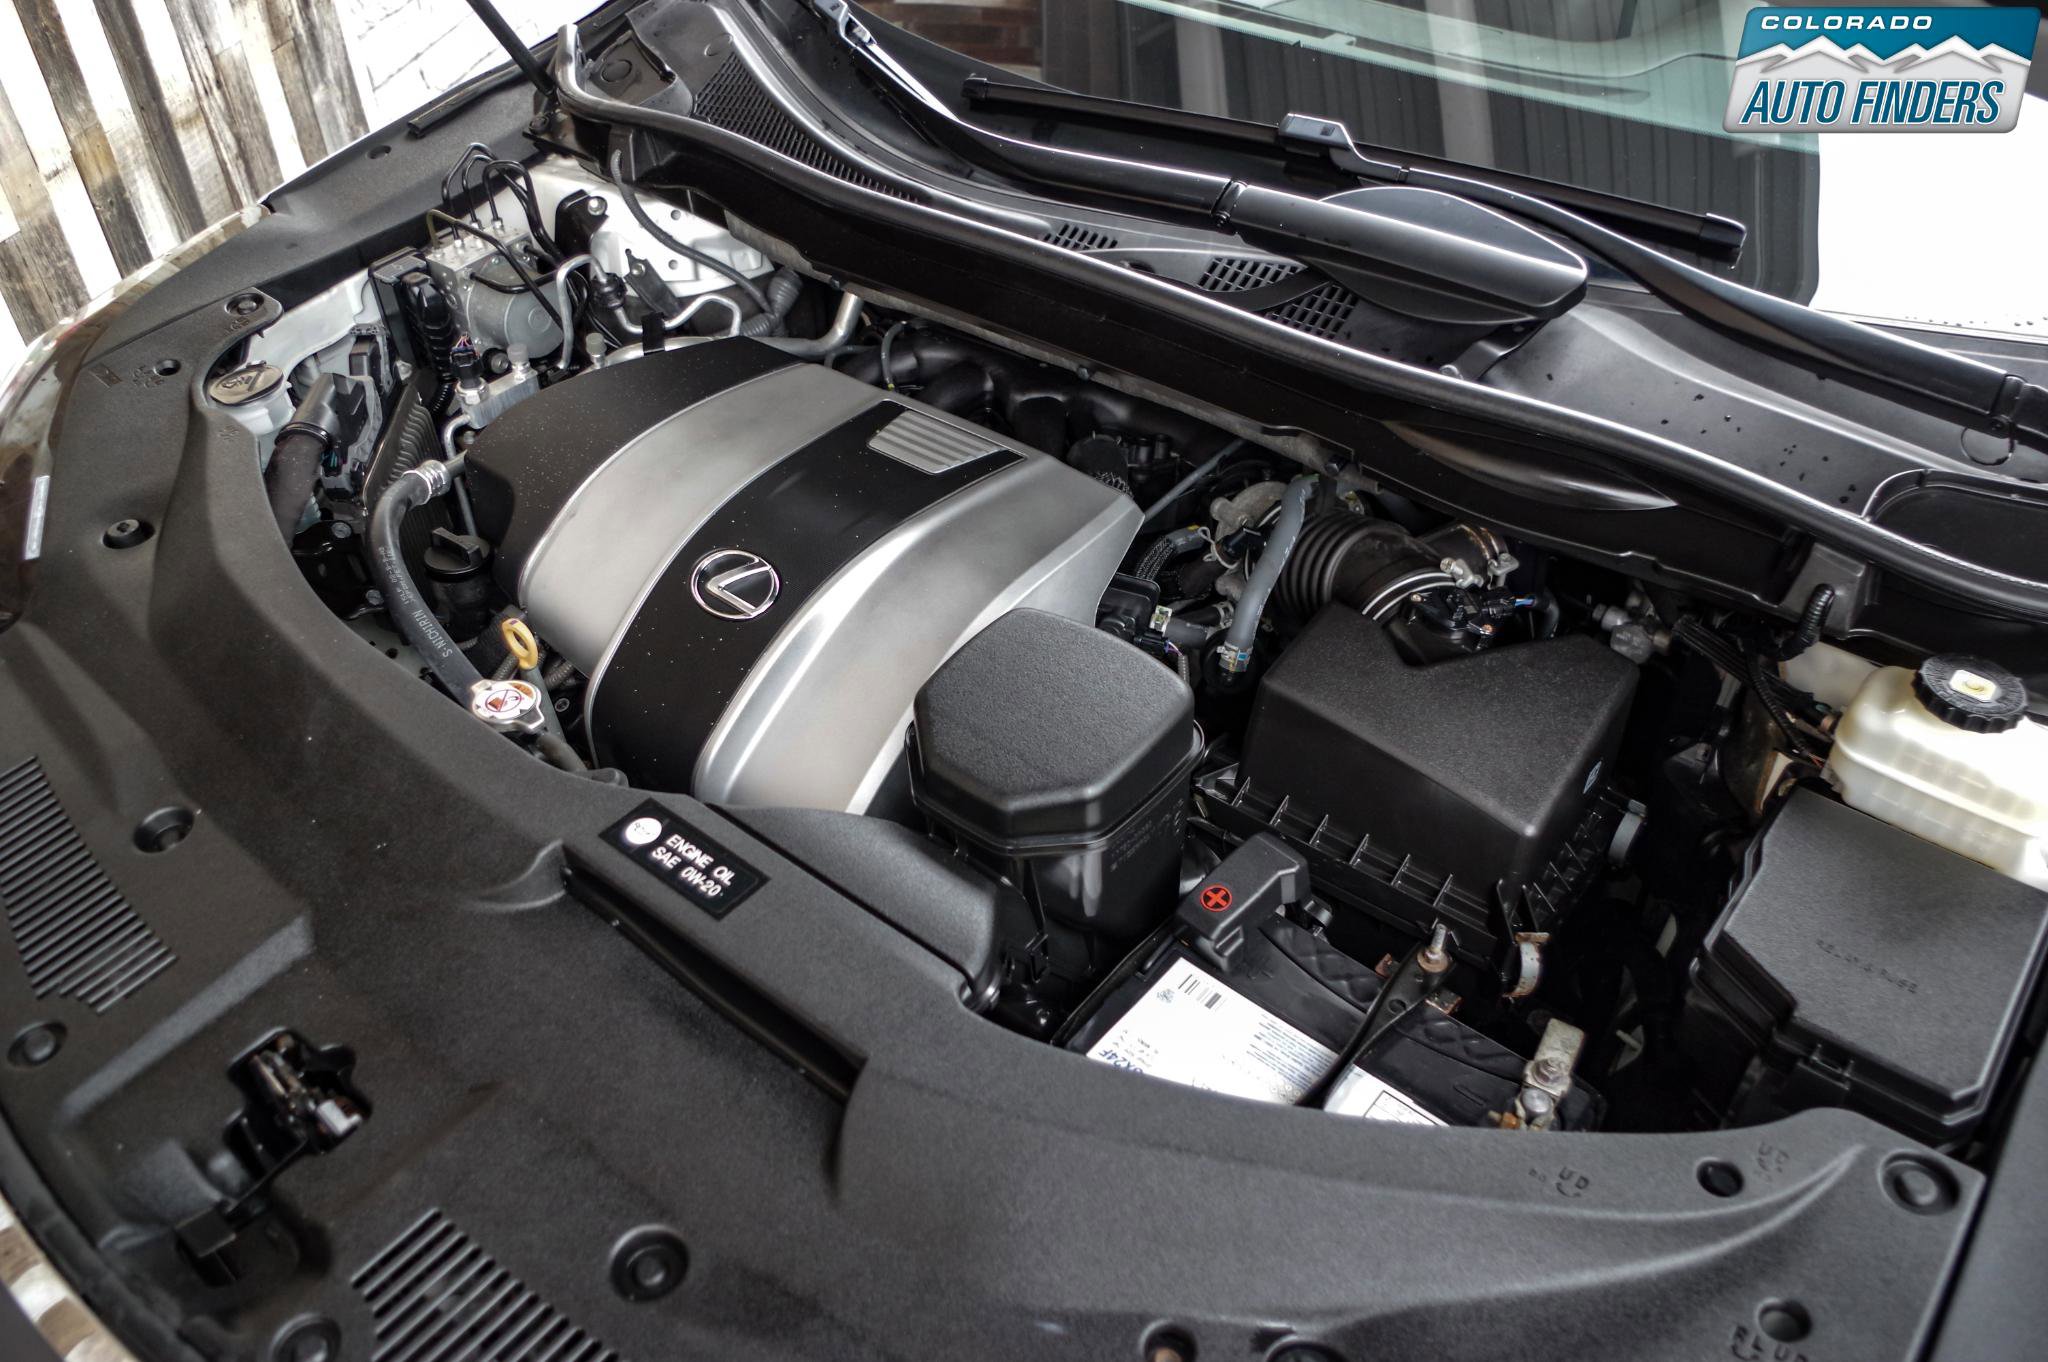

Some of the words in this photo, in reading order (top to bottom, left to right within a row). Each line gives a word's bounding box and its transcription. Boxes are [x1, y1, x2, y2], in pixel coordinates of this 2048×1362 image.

[651, 846, 682, 870] SAE
[665, 833, 715, 869] ENGINE
[712, 865, 736, 887] OIL
